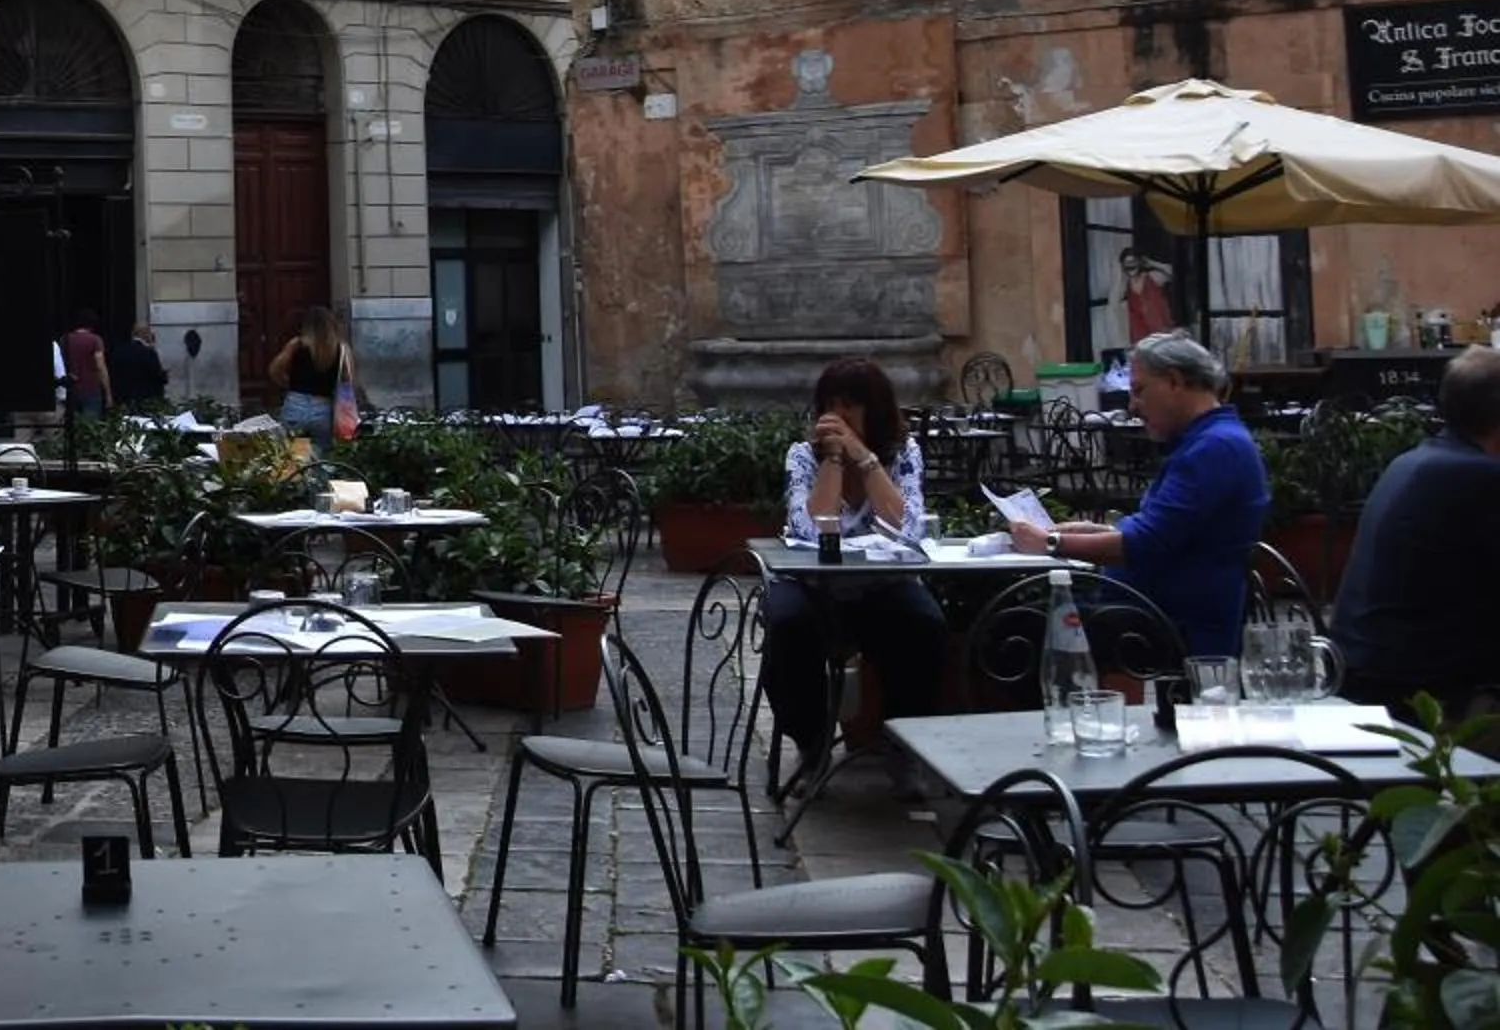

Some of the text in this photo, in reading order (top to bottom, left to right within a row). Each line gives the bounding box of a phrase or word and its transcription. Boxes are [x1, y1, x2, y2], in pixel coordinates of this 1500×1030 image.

[1361, 18, 1448, 43] Antica
[1367, 89, 1415, 103] Cucina
[1417, 85, 1477, 104] popolare
[93, 840, 119, 875] 1
